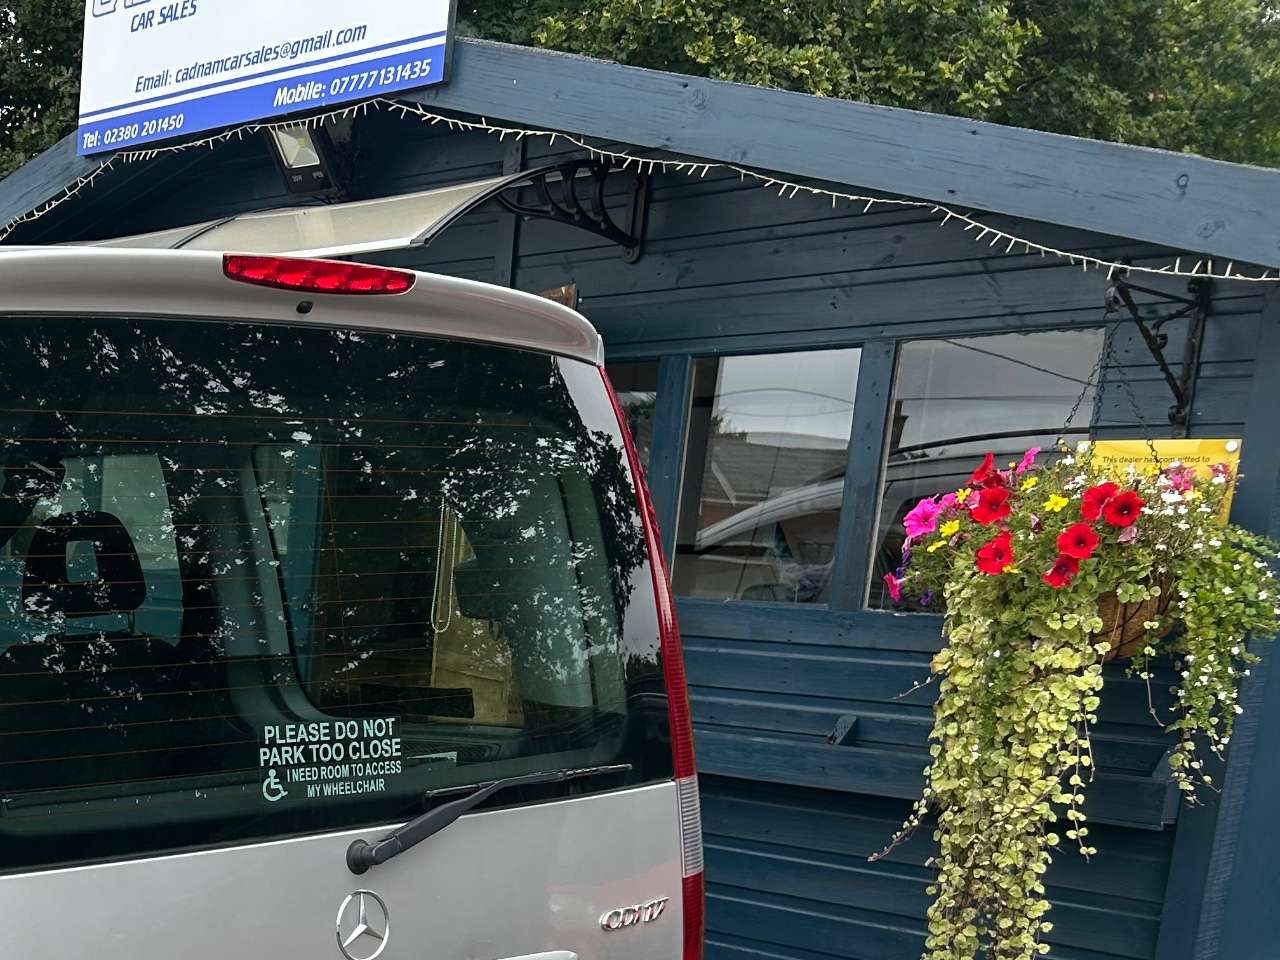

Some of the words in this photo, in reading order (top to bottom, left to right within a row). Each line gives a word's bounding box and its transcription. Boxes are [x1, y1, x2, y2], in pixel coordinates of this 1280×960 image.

[131, 10, 155, 32] CAR
[157, 0, 198, 25] SALES
[135, 69, 172, 93] Email:
[175, 24, 368, 84] cadnamcarsales@gmail.com
[273, 81, 327, 107] Mobile:
[329, 58, 432, 96] 07777131435
[83, 130, 101, 149] Tel:
[103, 124, 139, 144] 02380
[141, 113, 184, 136] 201450
[264, 722, 330, 745] PLEASE
[334, 721, 359, 740] DO
[363, 718, 396, 738] NOT
[259, 745, 306, 767] PARK
[309, 742, 345, 763] TOO
[349, 738, 402, 760] CLOSE
[287, 771, 291, 783] I
[292, 768, 319, 782] NEED
[321, 765, 349, 780] ROOM
[351, 764, 364, 777] TO
[365, 761, 402, 775] ACCESS
[307, 784, 321, 798] MY
[322, 778, 386, 796] WHEELCHAIR
